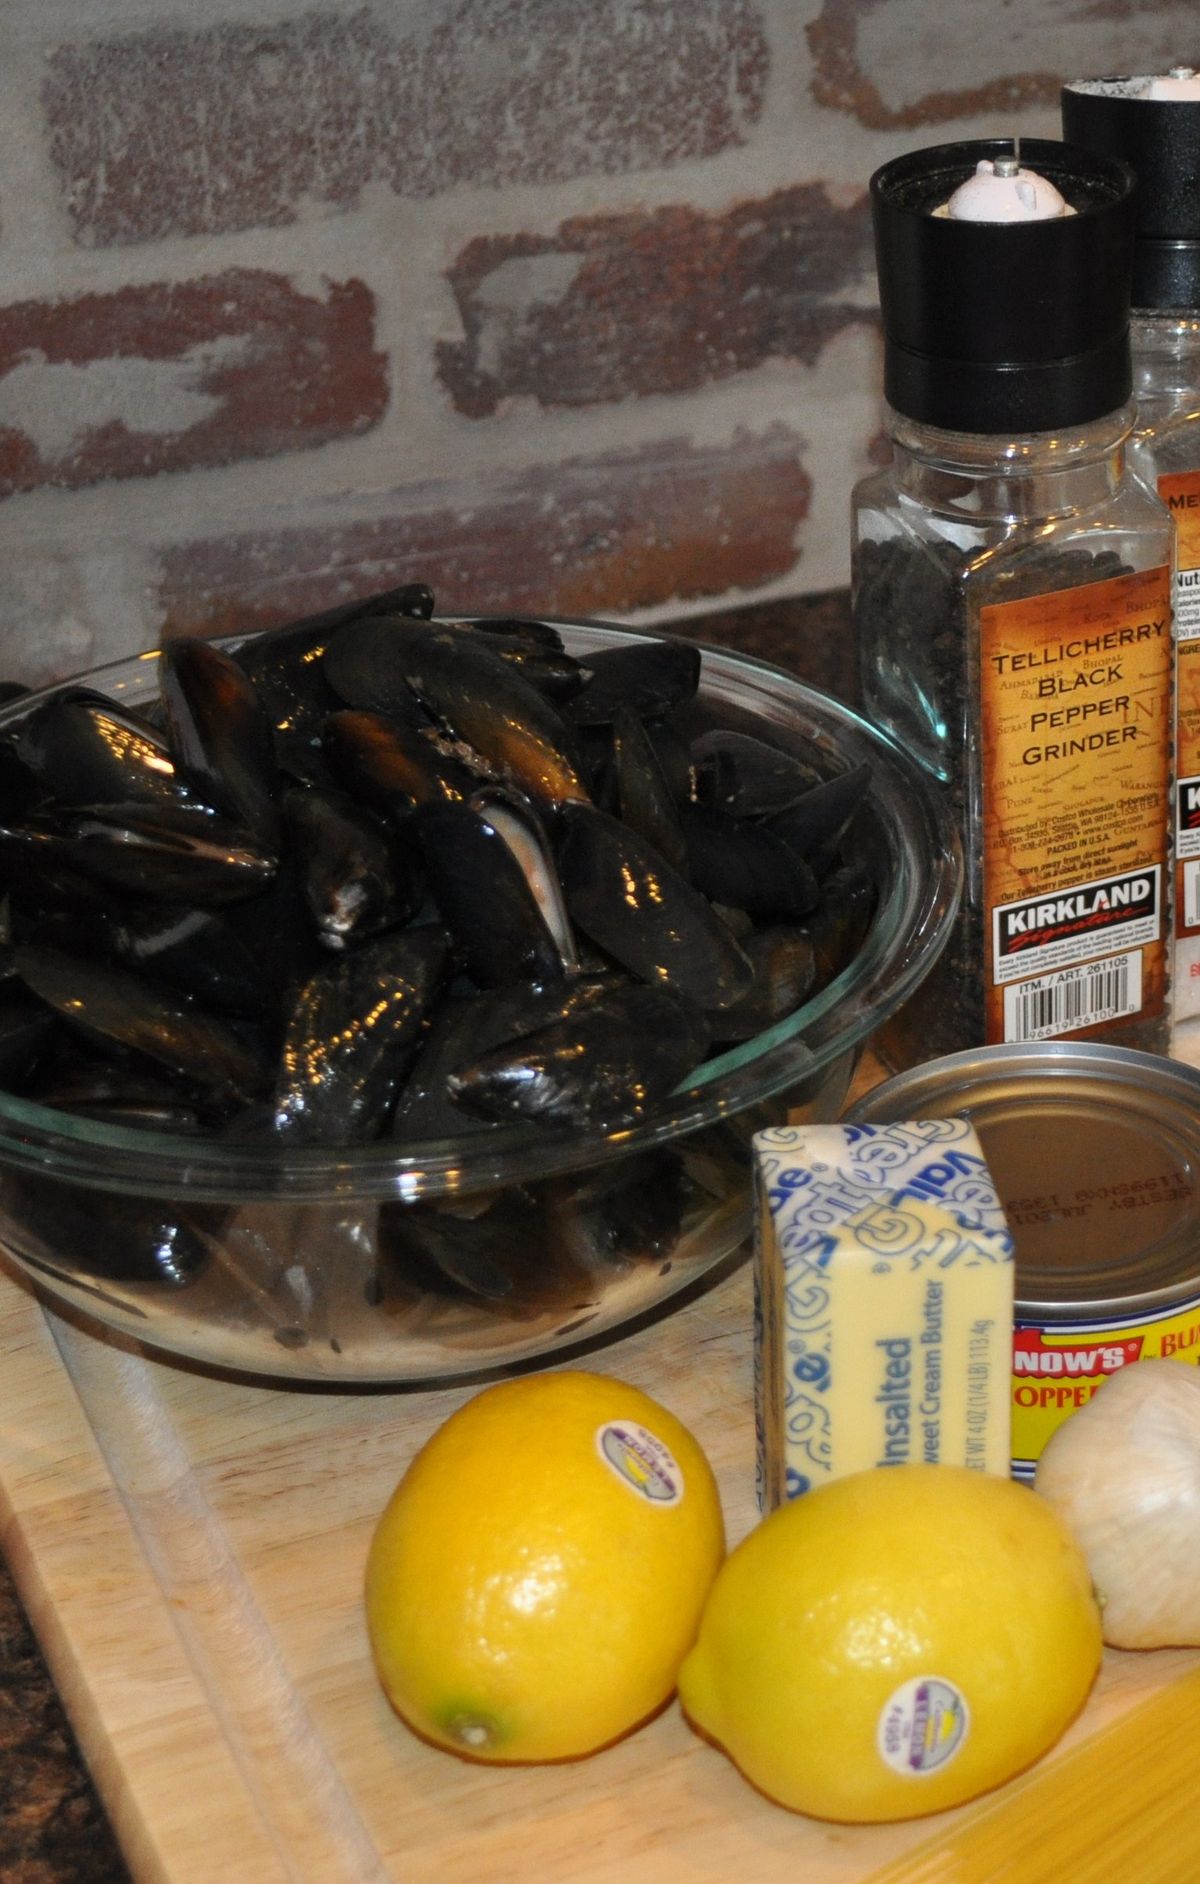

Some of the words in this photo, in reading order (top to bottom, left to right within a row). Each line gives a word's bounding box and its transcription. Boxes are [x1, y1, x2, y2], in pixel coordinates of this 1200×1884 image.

[991, 620, 1166, 674] TELLICHERRY
[1038, 664, 1124, 697] BLACK
[1031, 695, 1131, 732] PEPPER
[1022, 726, 1138, 765] GRINDER
[1047, 840, 1076, 855] PACKED
[1063, 853, 1080, 864] from
[1083, 846, 1105, 859] direct
[1007, 879, 1150, 936] KIRKLAND
[1019, 977, 1045, 994] ITM.
[1057, 969, 1083, 984] ART.
[1087, 956, 1128, 975] 261105
[1030, 1021, 1068, 1040] 96619
[1075, 1008, 1116, 1028] 26100
[920, 1279, 943, 1345] Butter
[967, 1361, 991, 1381] LB)
[1014, 1346, 1124, 1372] NOW'S
[920, 1349, 941, 1415] Cream
[1014, 1385, 1097, 1408] OPPE
[966, 1409, 987, 1424] OZ
[967, 1426, 987, 1434] 4
[921, 1419, 940, 1463] weet
[966, 1436, 986, 1455] WT
[966, 1456, 986, 1472] ET
